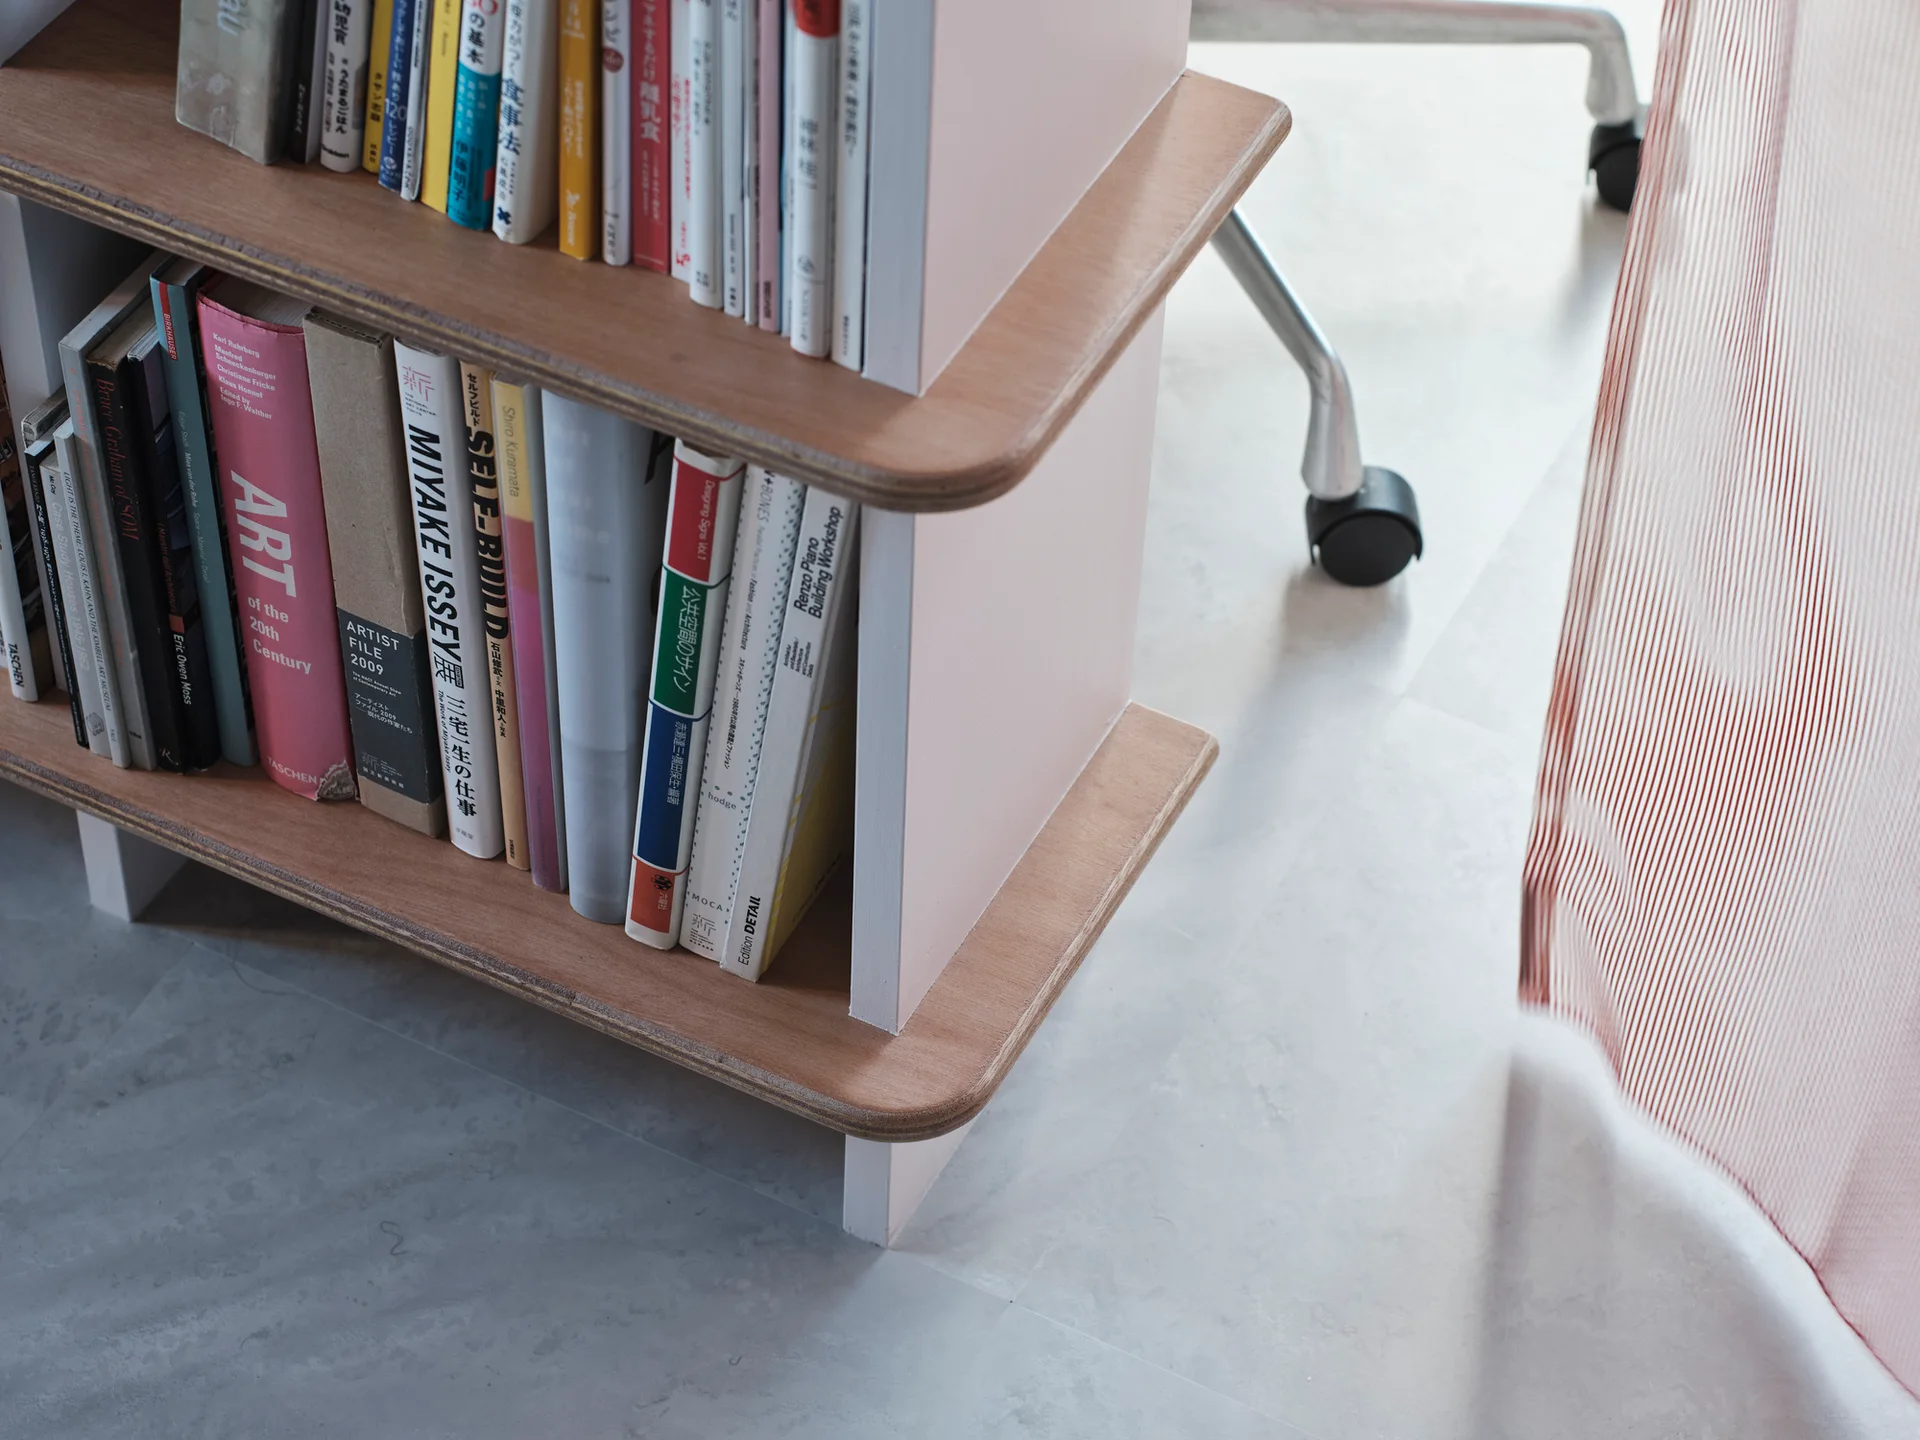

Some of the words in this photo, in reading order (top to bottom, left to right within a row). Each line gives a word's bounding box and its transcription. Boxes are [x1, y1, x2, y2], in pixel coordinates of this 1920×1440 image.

[213, 333, 227, 344] Karl
[228, 340, 260, 358] Ruhrberg
[214, 345, 243, 362] Manfred
[216, 352, 276, 380] Schneckenburger
[217, 364, 251, 384] Christiane
[252, 379, 276, 391] Fricke
[219, 375, 237, 389] Klaus
[220, 387, 241, 401] Edited
[242, 396, 251, 405] by
[96, 378, 115, 421] Bruce
[244, 404, 273, 420] Walther
[467, 373, 481, 427] セルフビルド
[503, 406, 516, 441] Shiro
[105, 425, 126, 483] Graham
[64, 471, 74, 497] LIGHT
[504, 443, 519, 498] Kuramata
[115, 486, 132, 505] of
[408, 424, 452, 560] MIYAKE
[700, 480, 716, 518] Designing
[52, 501, 63, 529] Case
[69, 504, 79, 520] THE
[121, 504, 139, 541] SOM
[231, 469, 296, 598] ART
[700, 519, 711, 541] Signs
[817, 506, 844, 571] Workshop
[56, 534, 69, 566] Study
[77, 548, 87, 569] LOUIS
[801, 537, 819, 568] Piano
[63, 571, 77, 611] Houses
[82, 578, 93, 601] KAHN
[748, 578, 758, 601] Fashion
[794, 571, 812, 613] Renzo
[808, 571, 834, 619] Building
[86, 602, 96, 619] AND
[247, 596, 261, 611] of
[264, 603, 289, 623] the
[250, 616, 280, 642] 20th
[346, 620, 400, 651] ARTIST
[673, 585, 701, 693] 公共空間のサイン
[741, 613, 753, 651] Architecture
[173, 634, 185, 653] Eric
[253, 639, 312, 675] Century
[349, 636, 383, 660] FILE
[8, 643, 25, 688] TASCHEN
[96, 665, 105, 680] ART
[176, 653, 188, 682] Owen
[350, 654, 384, 675] 2009
[99, 681, 111, 711] MUSEUM
[182, 682, 192, 705] Moss
[355, 692, 390, 711] アーティスト
[356, 699, 379, 713] ファイル
[380, 710, 397, 721] 2009
[442, 729, 450, 753] Miyake
[446, 694, 477, 816] 三宅一生の仕事
[267, 756, 318, 785] TASCHEN
[708, 791, 737, 811] hodge
[692, 893, 723, 912] MOCA
[744, 896, 761, 935] DETAIL
[738, 931, 753, 965] Edition
